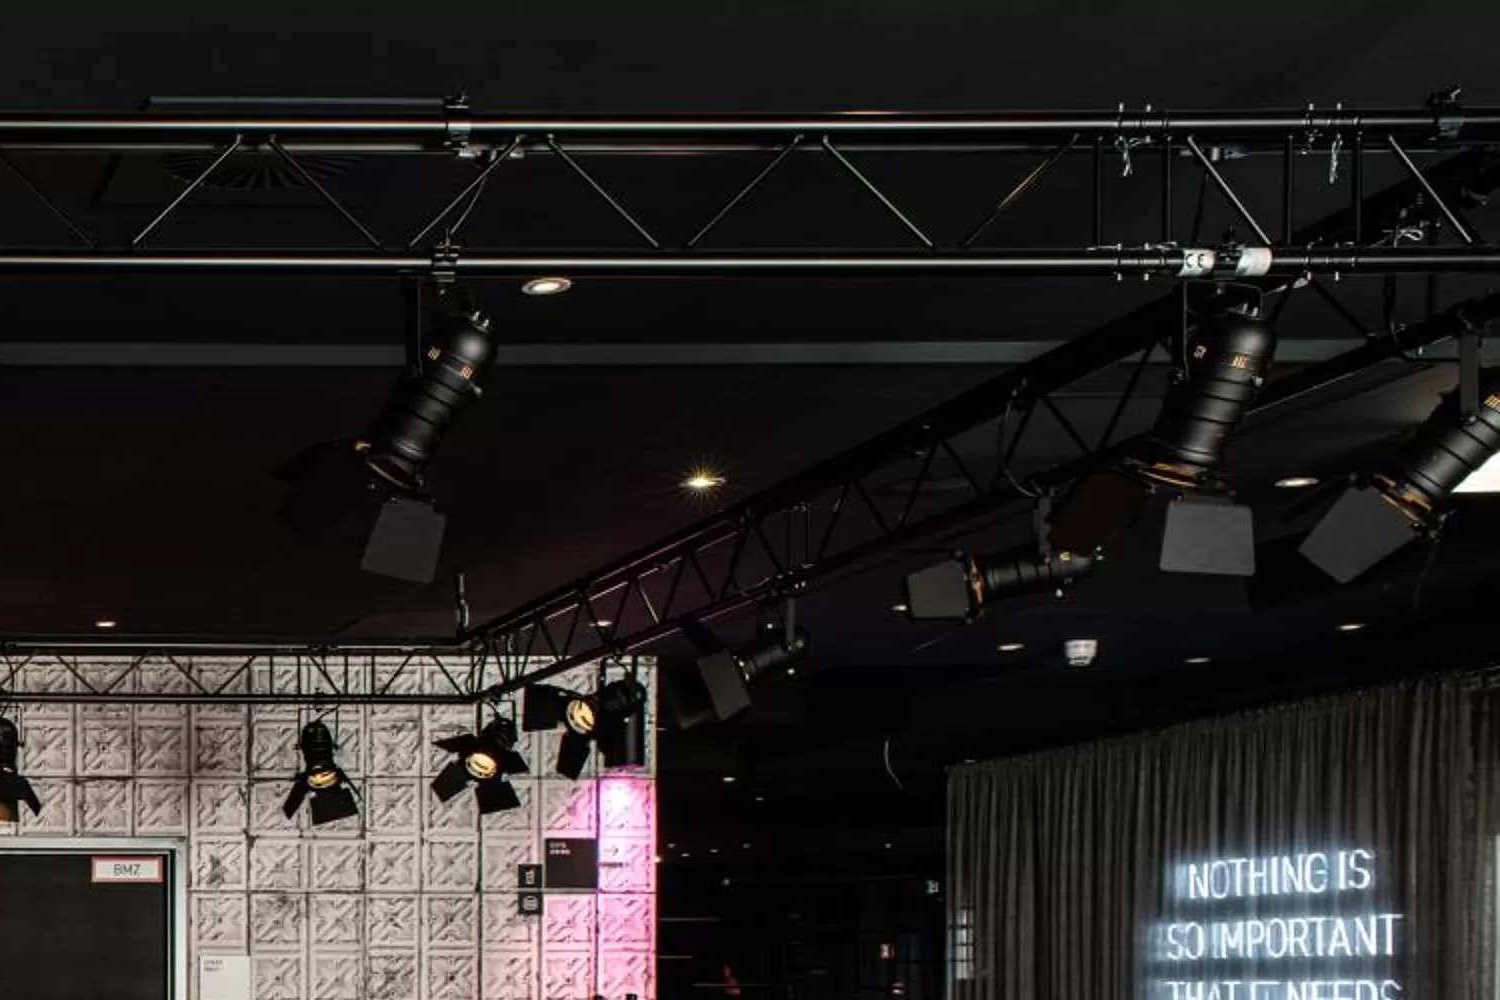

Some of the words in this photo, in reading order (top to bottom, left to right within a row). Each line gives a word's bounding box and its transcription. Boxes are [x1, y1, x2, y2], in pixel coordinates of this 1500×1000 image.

[113, 863, 141, 876] BMZ
[1188, 852, 1329, 899] NOTHING
[1337, 849, 1375, 890] IS
[1167, 921, 1204, 960] SO
[1211, 913, 1404, 959] IMPORTANT
